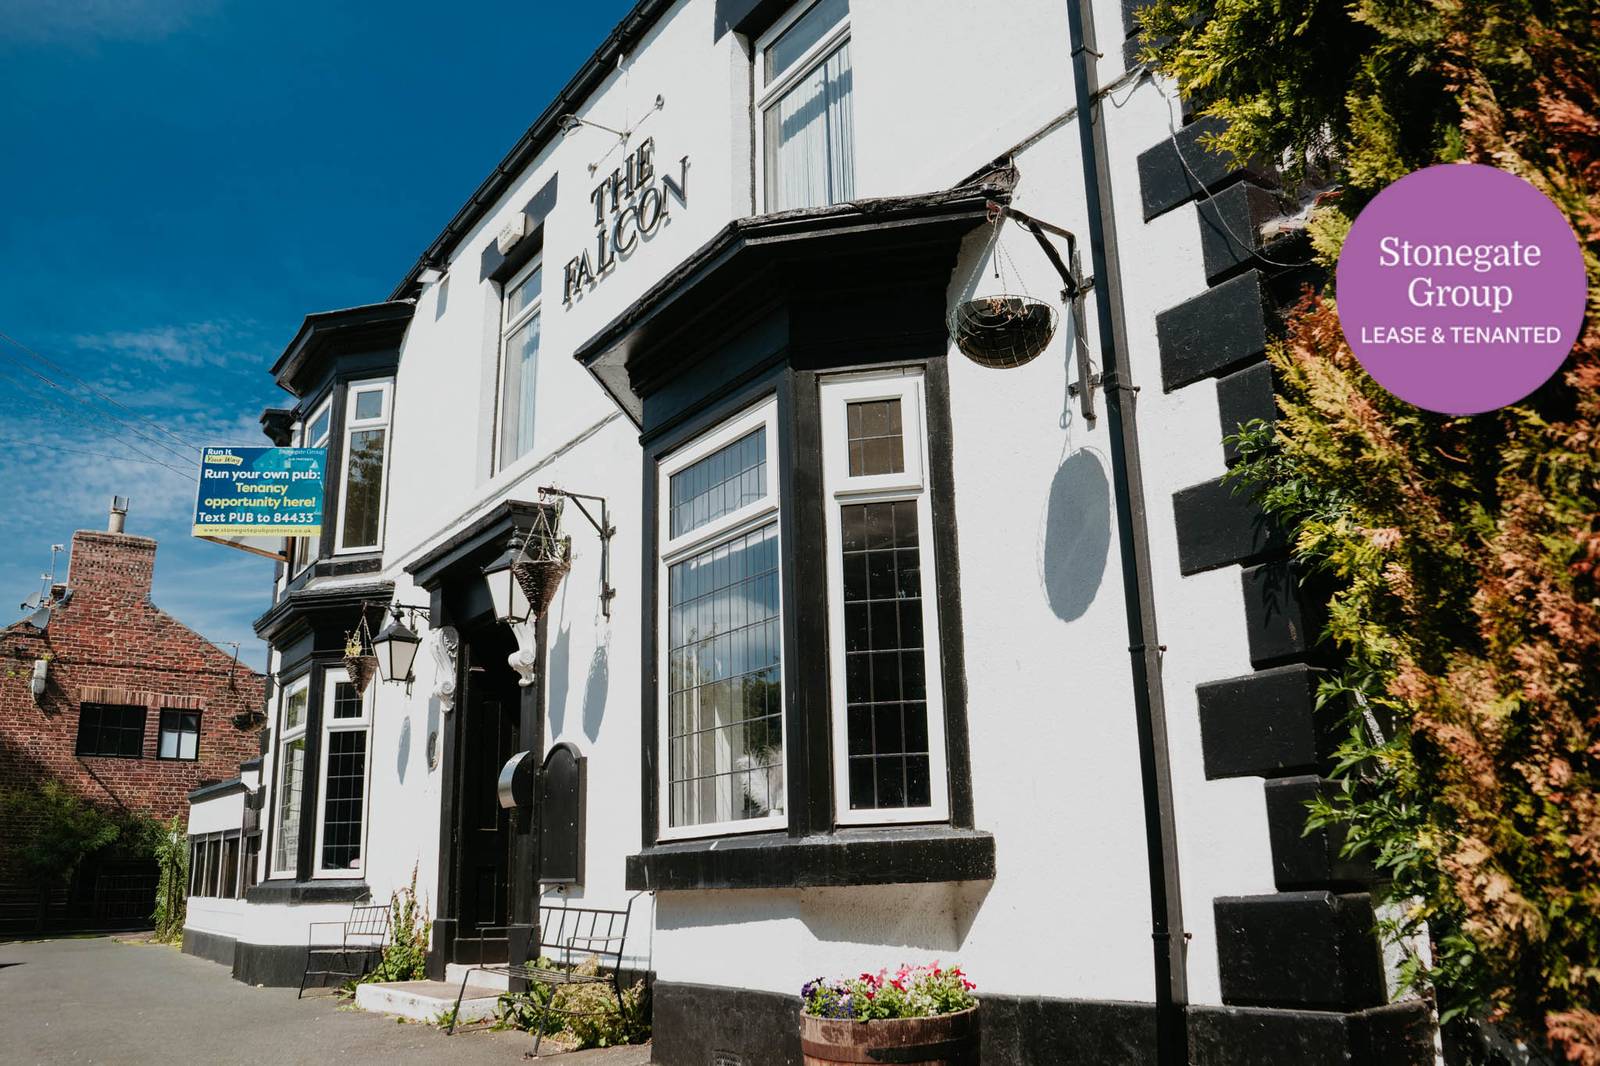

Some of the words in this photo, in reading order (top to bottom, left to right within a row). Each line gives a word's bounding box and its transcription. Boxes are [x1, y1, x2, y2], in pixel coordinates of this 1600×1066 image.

[590, 136, 655, 228] THE
[561, 155, 690, 306] FALCON
[204, 468, 230, 479] Run
[231, 470, 260, 481] your
[262, 471, 290, 480] own
[291, 469, 321, 481] pub:
[235, 482, 289, 495] Tenancy
[204, 496, 281, 509] opportunity
[283, 496, 316, 507] here!
[199, 512, 226, 522] Text
[228, 513, 254, 522] PUB
[256, 513, 271, 522] to
[273, 513, 314, 523] 84433
